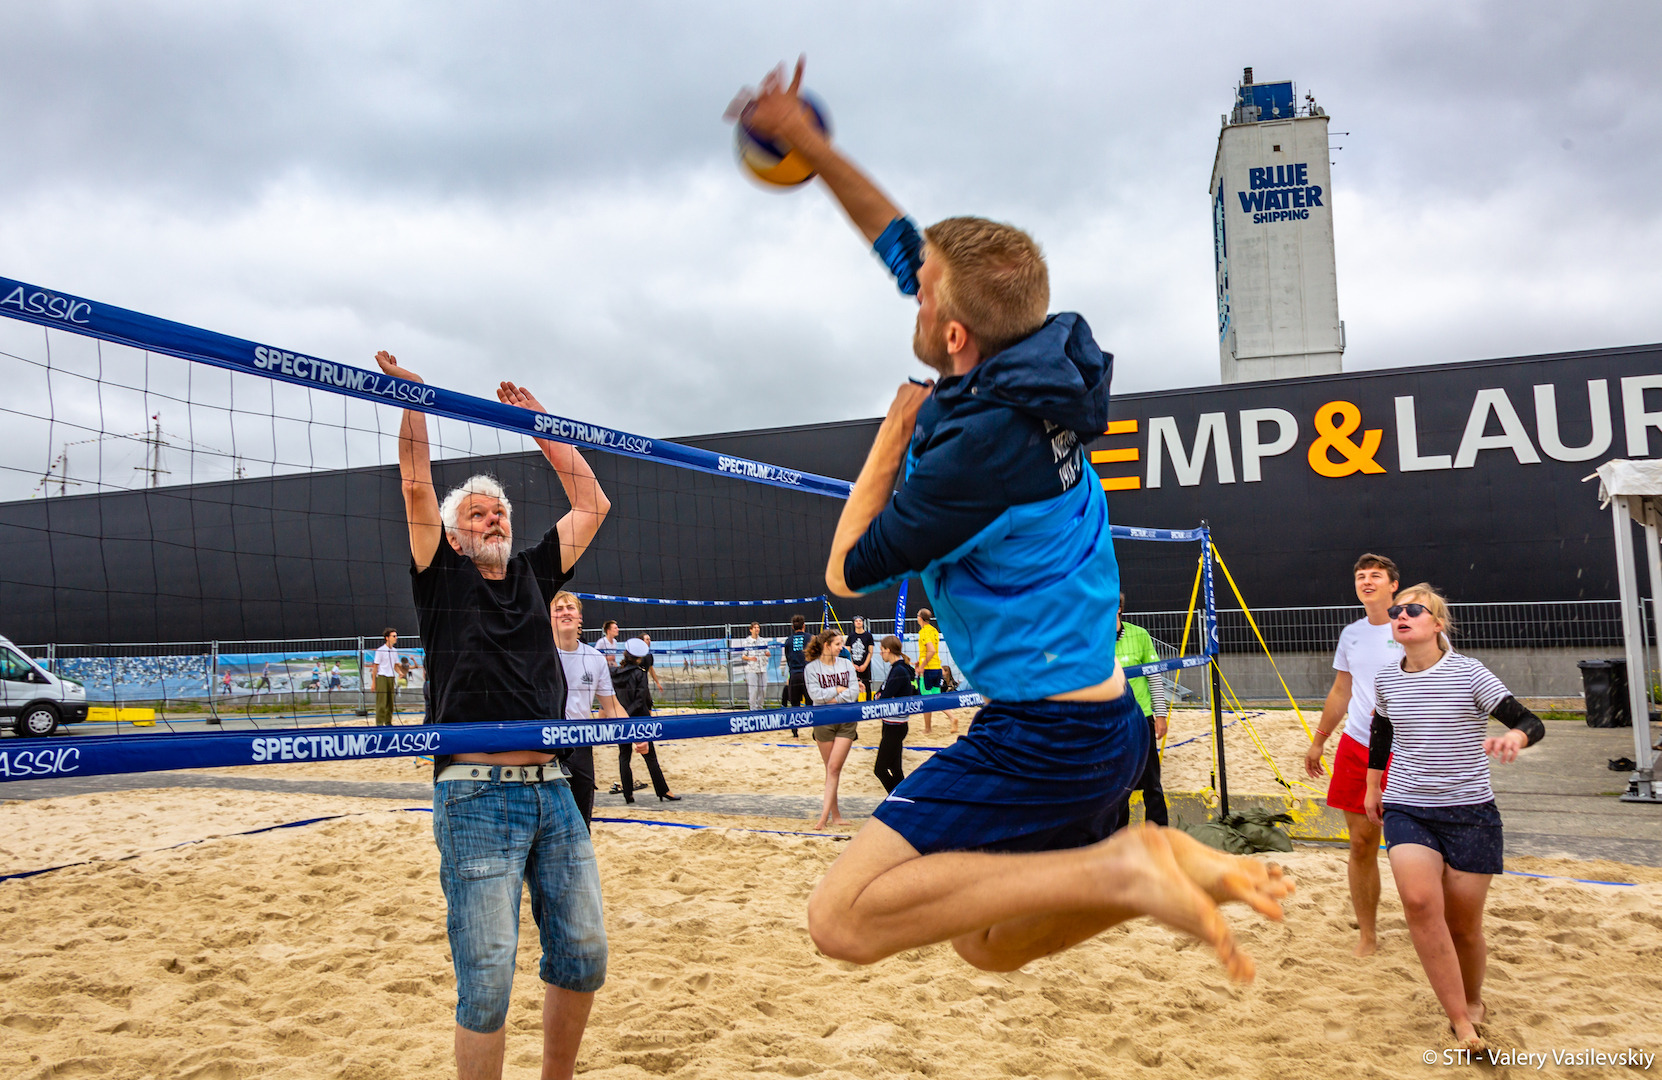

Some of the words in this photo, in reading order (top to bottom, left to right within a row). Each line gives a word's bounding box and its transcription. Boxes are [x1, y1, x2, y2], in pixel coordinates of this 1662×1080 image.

[1249, 163, 1308, 190] BLUE
[1238, 185, 1324, 213] WATER
[1253, 209, 1309, 224] SHIPPING
[1307, 400, 1387, 478] &
[1394, 373, 1662, 473] LAUR
